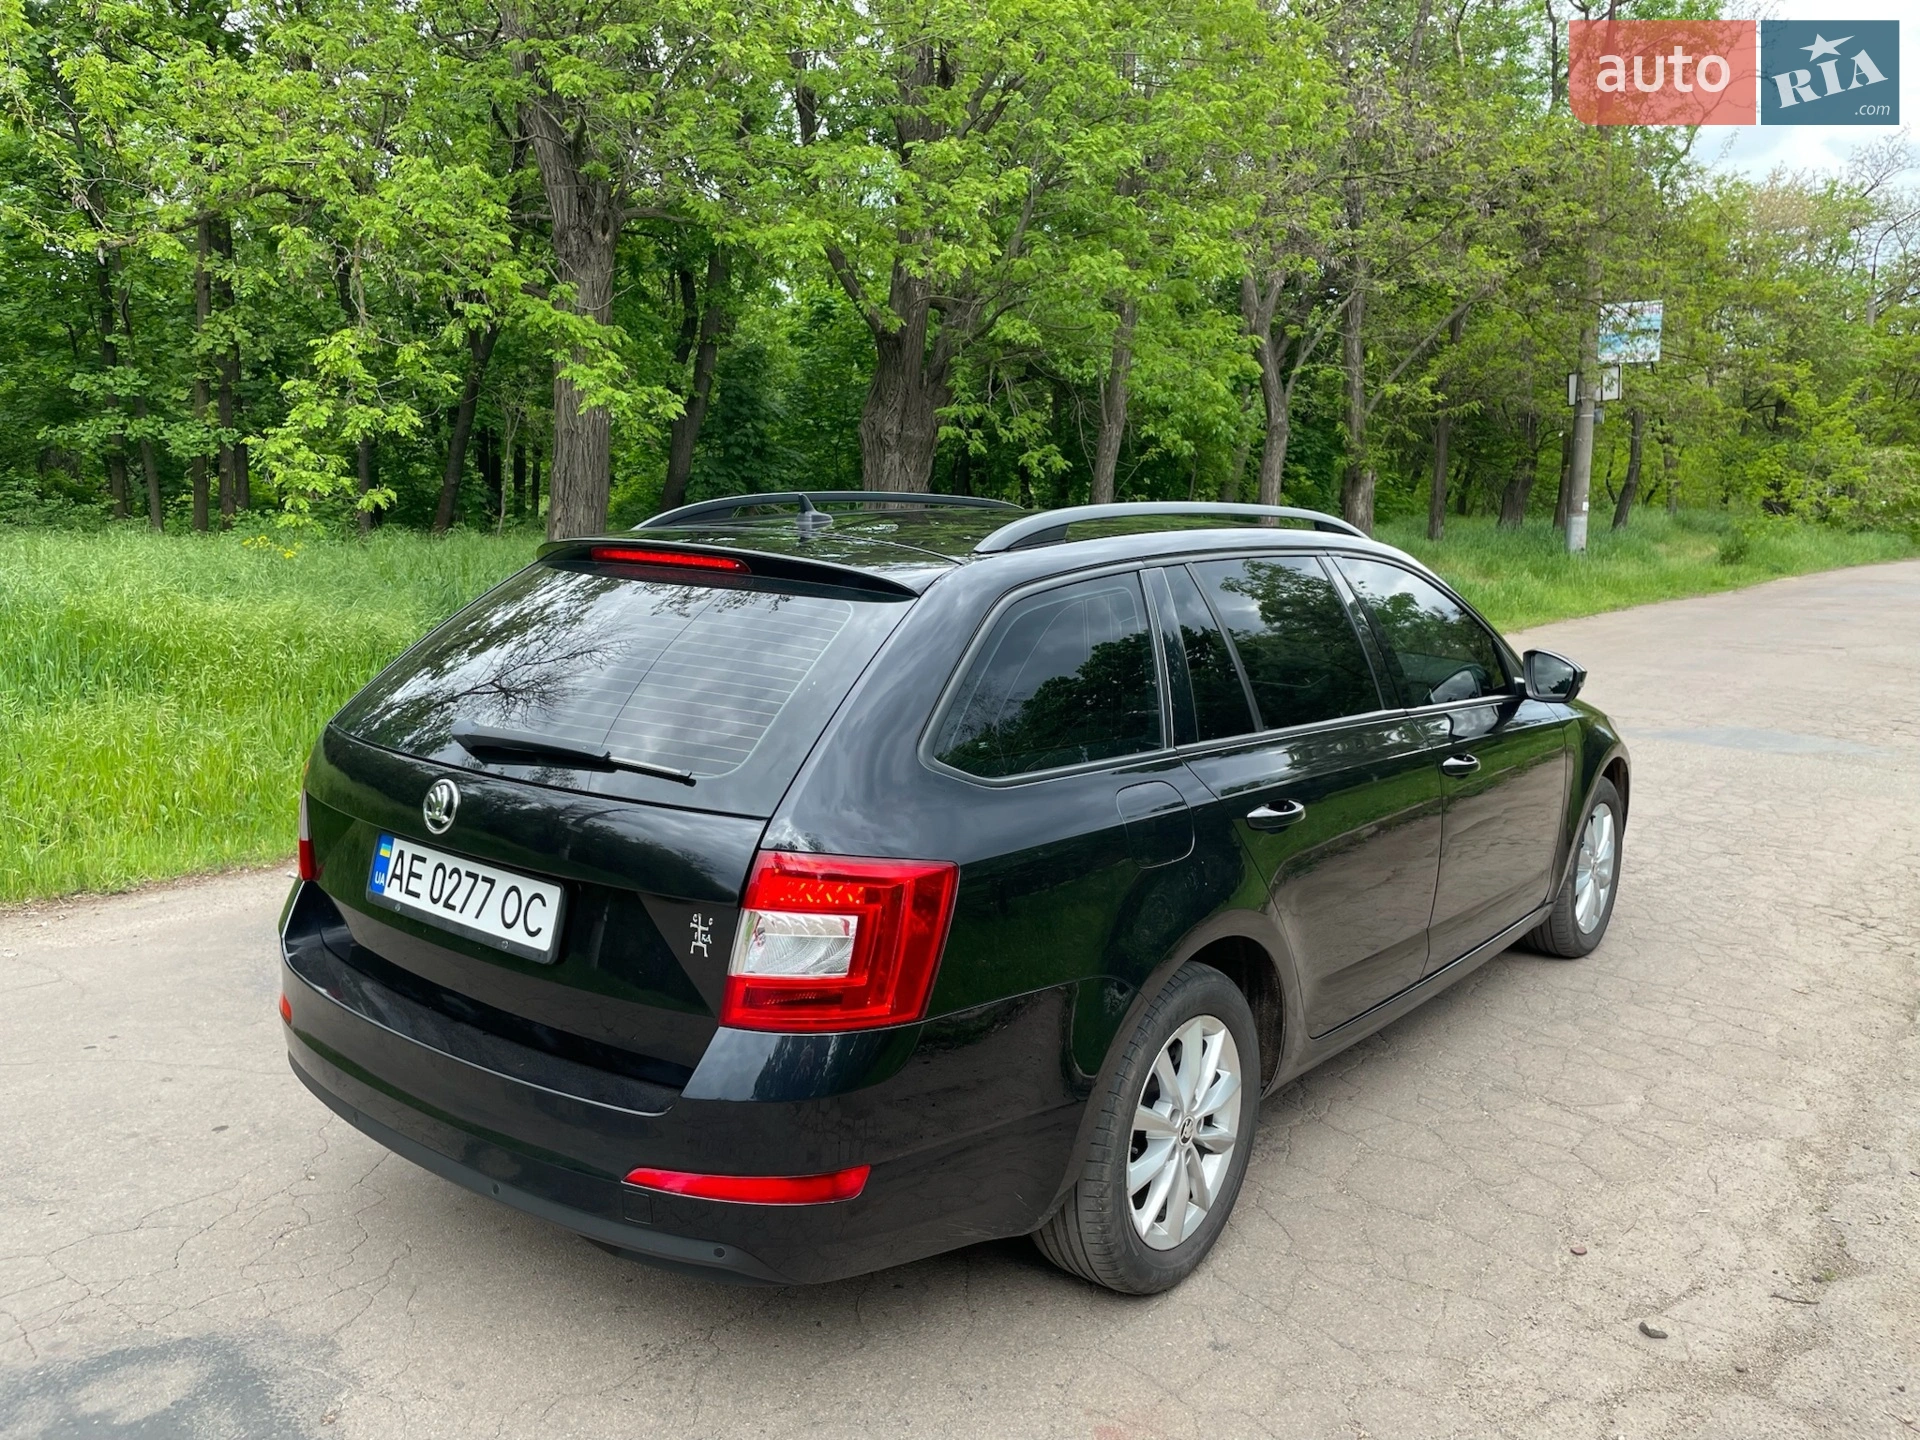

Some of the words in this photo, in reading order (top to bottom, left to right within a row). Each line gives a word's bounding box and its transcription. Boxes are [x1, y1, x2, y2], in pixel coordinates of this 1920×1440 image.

[374, 871, 386, 887] UA
[387, 849, 427, 899] AE
[429, 862, 496, 920] 0277
[500, 885, 547, 938] OC
